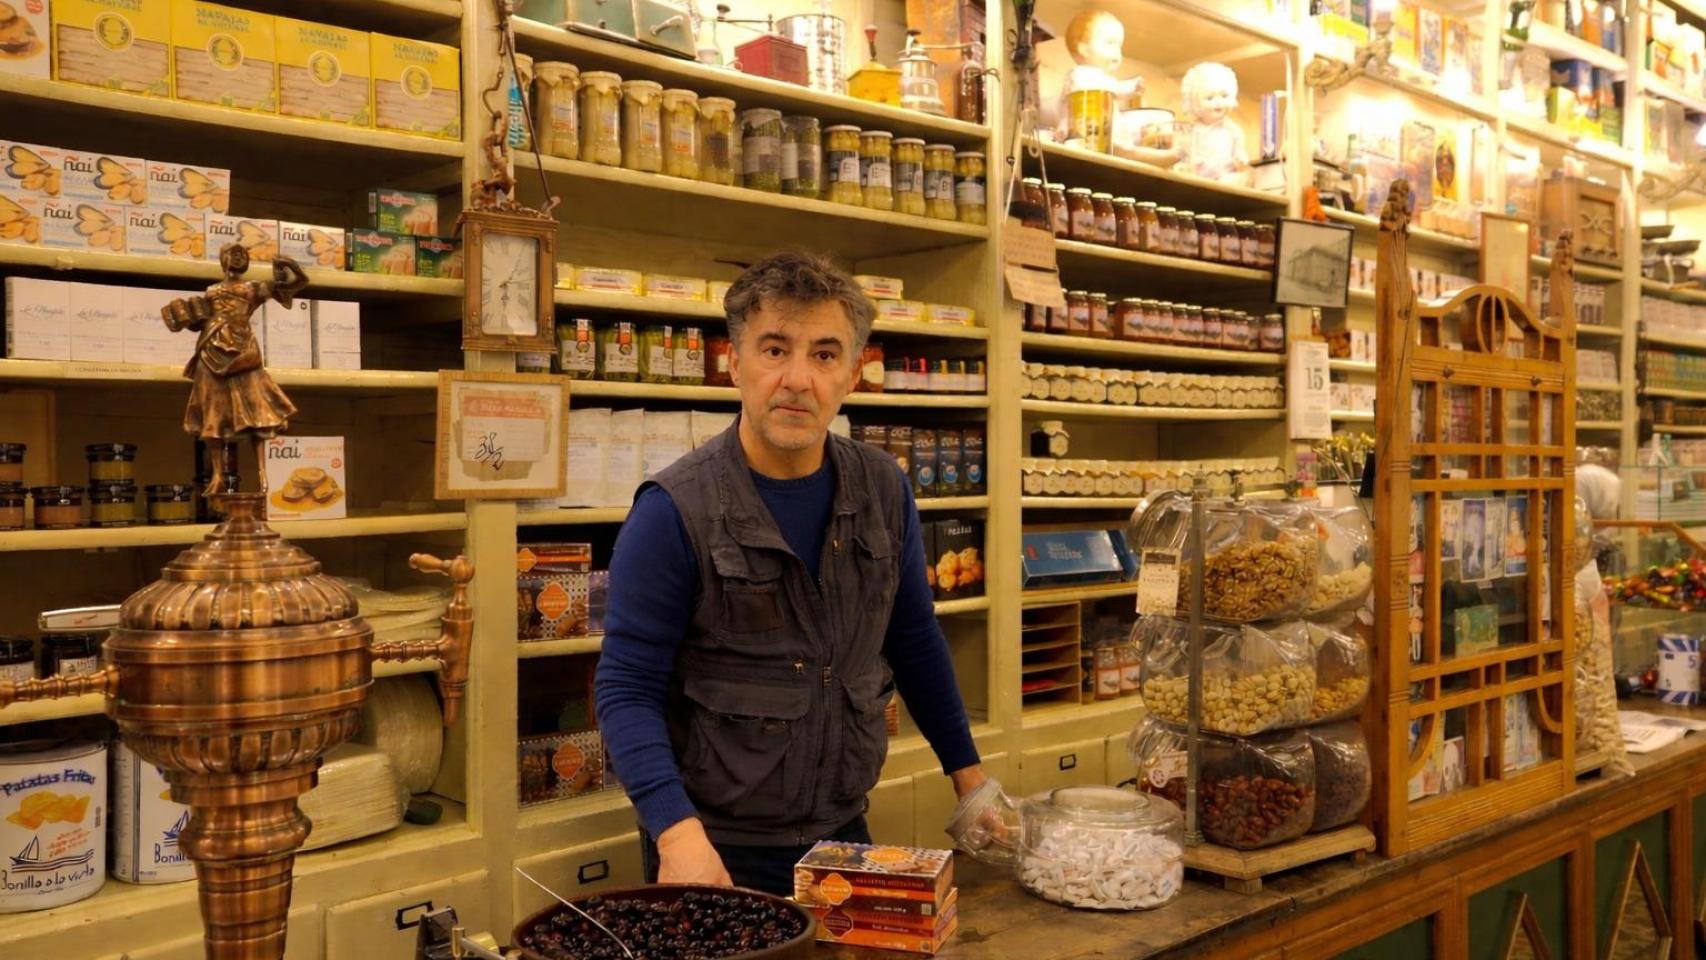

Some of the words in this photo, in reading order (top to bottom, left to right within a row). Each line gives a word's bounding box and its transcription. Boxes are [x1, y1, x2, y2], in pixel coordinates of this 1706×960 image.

[64, 155, 93, 173] ñai
[150, 166, 178, 183] ñai
[43, 199, 73, 220] ñai
[129, 212, 157, 229] ñai
[209, 220, 235, 236] ñai
[1305, 367, 1324, 390] 15
[269, 439, 301, 459] ñai
[0, 771, 60, 796] Patatas
